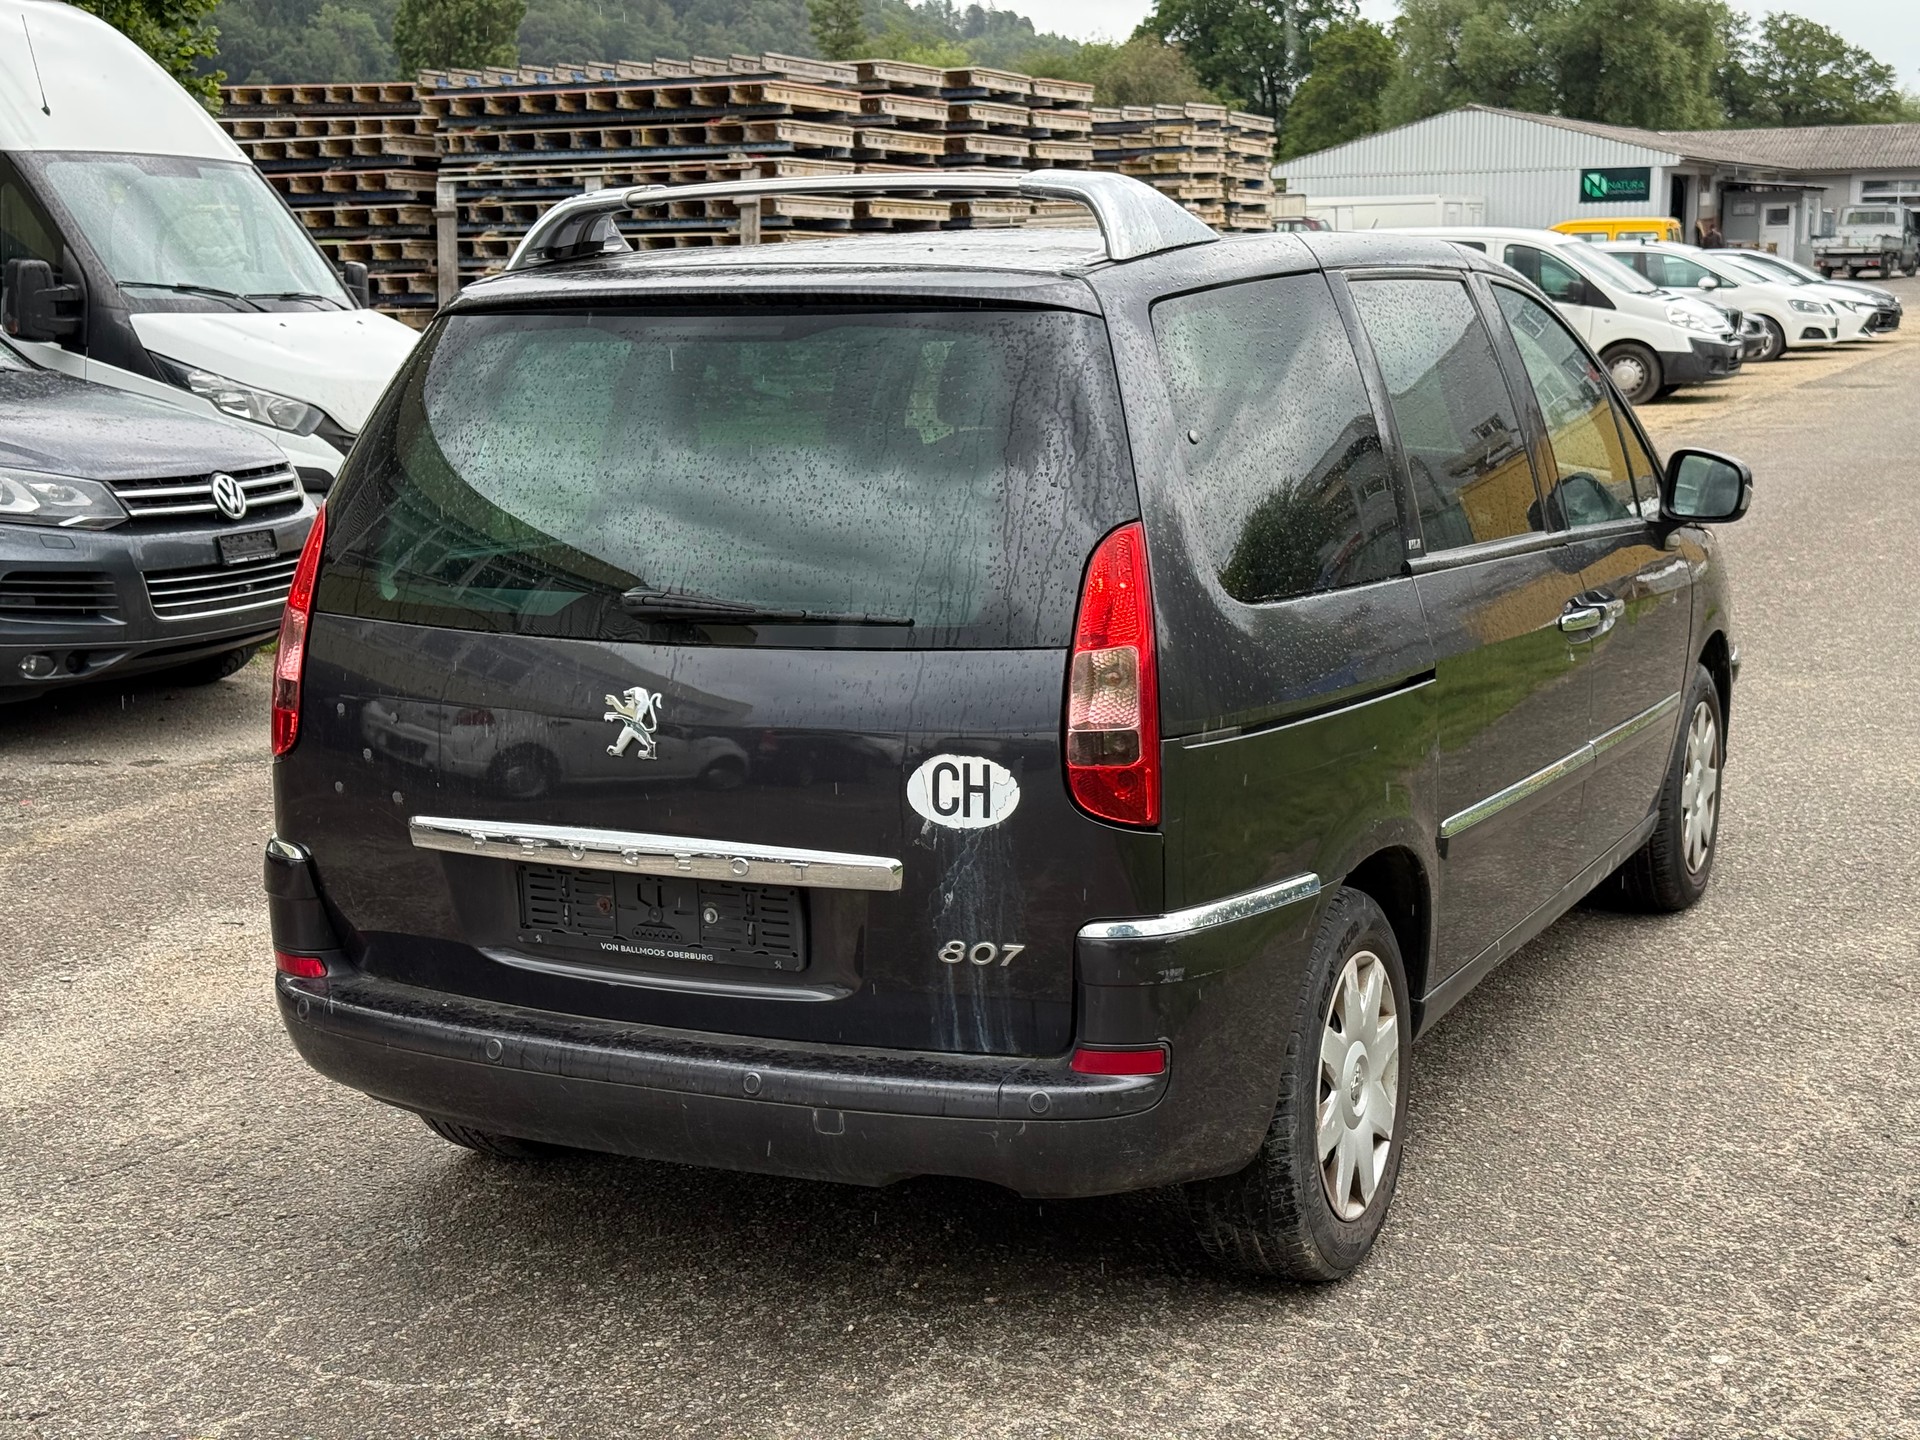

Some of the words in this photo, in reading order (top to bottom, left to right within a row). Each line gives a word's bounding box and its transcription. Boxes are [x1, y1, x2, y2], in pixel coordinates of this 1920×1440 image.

[1607, 180, 1646, 191] NATURA
[213, 474, 246, 519] VW
[932, 762, 991, 819] CH
[470, 831, 810, 881] PEUGEOT
[600, 942, 619, 952] VON
[620, 945, 665, 957] BALLMOOS
[667, 951, 714, 962] OBERBURG
[938, 940, 1026, 967] 807
